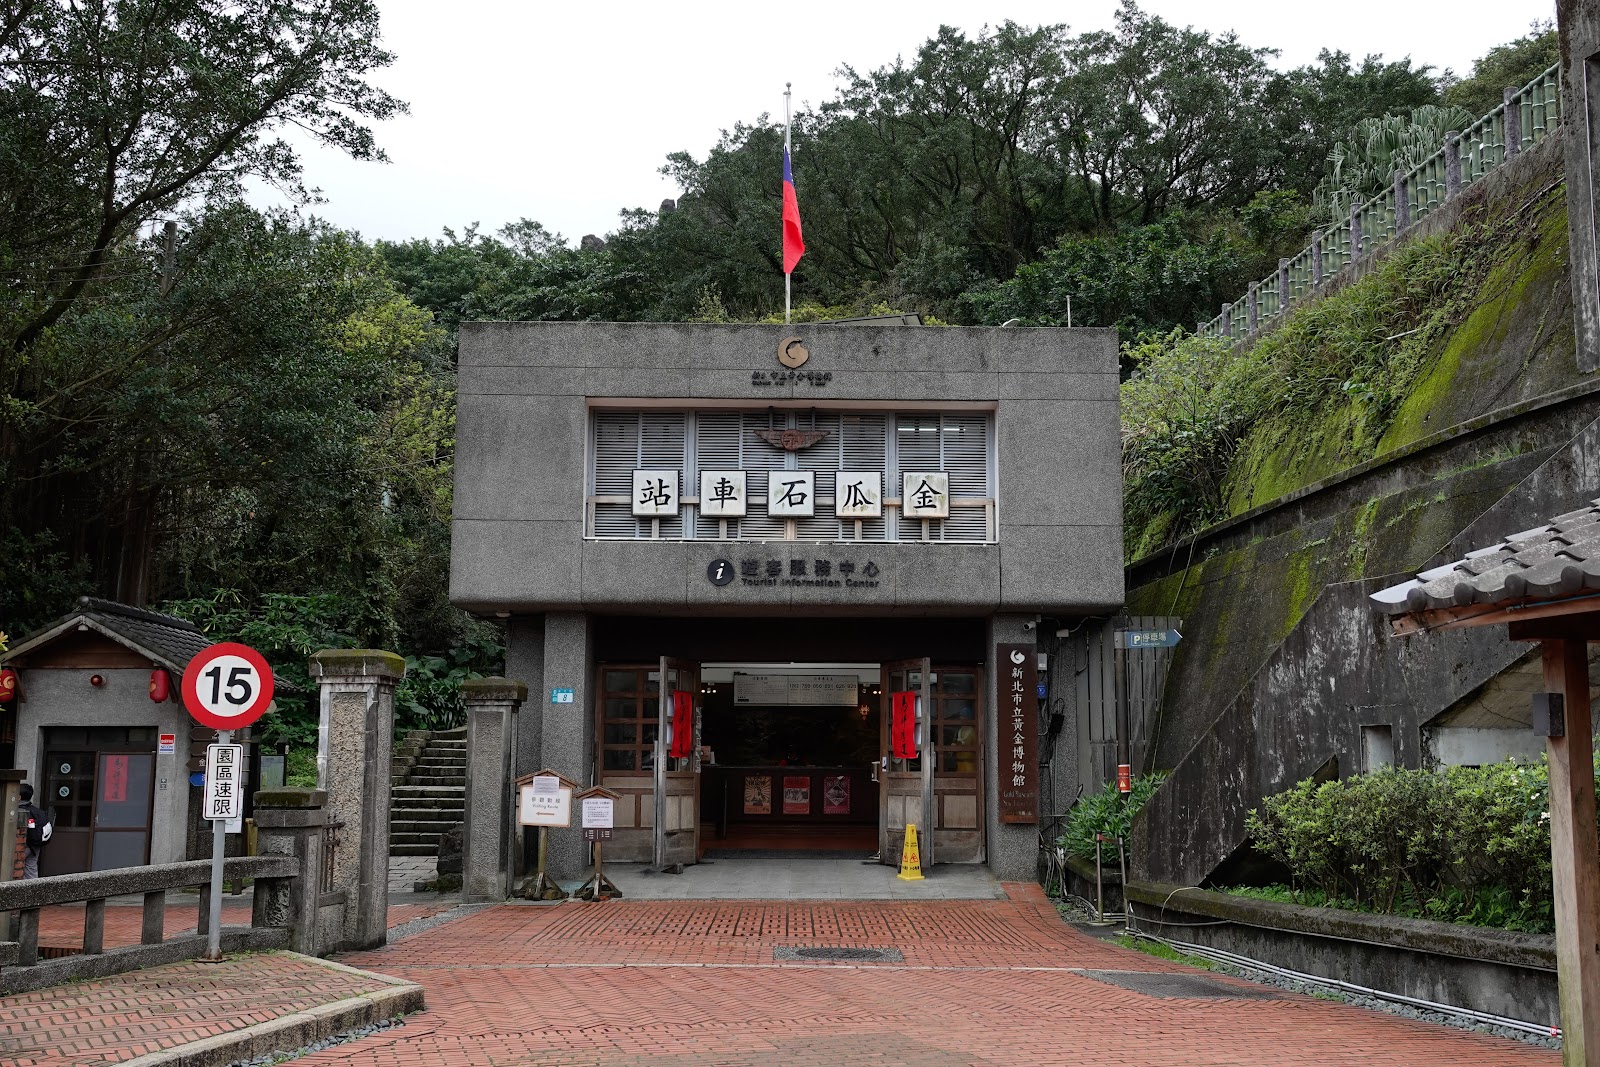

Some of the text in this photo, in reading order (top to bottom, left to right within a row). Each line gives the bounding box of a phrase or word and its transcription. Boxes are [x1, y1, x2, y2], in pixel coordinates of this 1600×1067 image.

[741, 558, 880, 578] 遊客服務中心
[741, 578, 880, 588] Tourist Information Center
[205, 666, 252, 705] 15
[562, 693, 568, 702] 8
[1011, 667, 1026, 787] 新北市立黃金博物館
[213, 748, 234, 815] 園區速限
